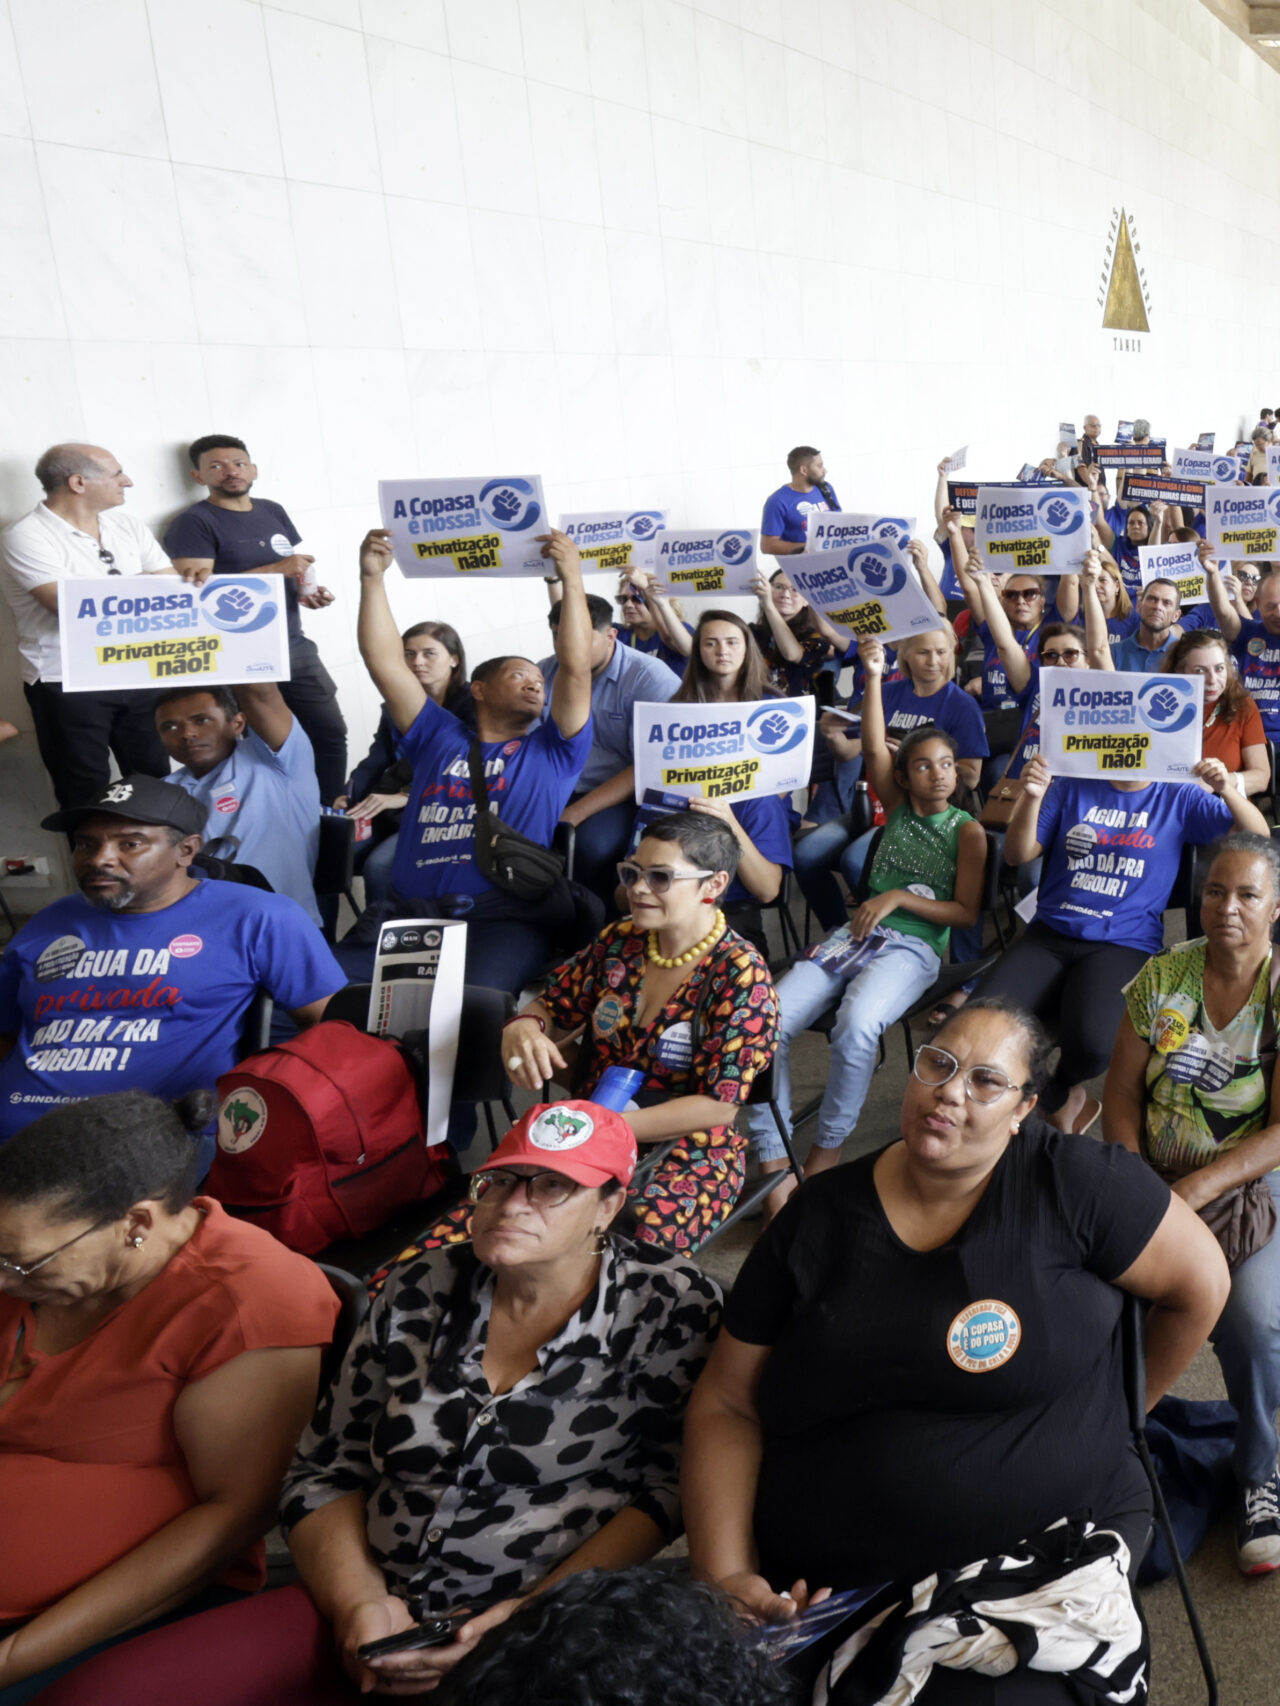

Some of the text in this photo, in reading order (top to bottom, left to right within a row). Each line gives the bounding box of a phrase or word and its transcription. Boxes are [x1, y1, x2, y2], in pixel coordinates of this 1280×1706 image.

[1132, 487, 1159, 498] DEFENDER
[394, 494, 475, 518] A Copasa
[981, 504, 1034, 520] A Copasa
[1214, 500, 1264, 513] A Copasa
[408, 508, 481, 535] é nossa!
[986, 516, 1038, 534] é nossa!
[1221, 509, 1267, 525] é nossa!
[816, 525, 869, 538] A Copasa
[1223, 529, 1276, 542] Privatização
[417, 535, 500, 557] Privatização
[661, 539, 713, 555] A Copasa
[990, 537, 1050, 553] Privatização
[1247, 541, 1272, 554] não!
[458, 550, 496, 570] não!
[1017, 550, 1046, 566] não!
[1148, 553, 1192, 569] A Copasa
[671, 567, 724, 583] Privatização
[696, 577, 722, 592] não!
[77, 593, 193, 619] A Copasa
[96, 608, 198, 636] é nossa!
[103, 636, 218, 662] Privatização
[156, 652, 210, 676] não!
[1053, 688, 1133, 709] A Copasa
[888, 710, 918, 728] ÁGUA
[1064, 706, 1136, 726] é nossa!
[648, 720, 741, 743] A Copasa
[662, 734, 744, 761] é nossa!
[1066, 734, 1149, 752] Privatização
[1102, 749, 1141, 769] não!
[666, 760, 759, 784] Privatização
[708, 774, 751, 798] não!
[1083, 806, 1149, 828] ÁGUA DA
[1096, 852, 1115, 873] DÁ
[1115, 857, 1145, 878] PRA
[66, 949, 129, 979] GUA
[131, 948, 171, 976] DA
[34, 976, 183, 1022] privada
[71, 1015, 113, 1043] DÁ
[106, 1018, 161, 1042] PRA
[25, 1047, 118, 1072] ENGOLIR
[963, 1320, 1004, 1337] A COPASA
[971, 1337, 982, 1348] DO
[984, 1332, 1005, 1345] POVO
